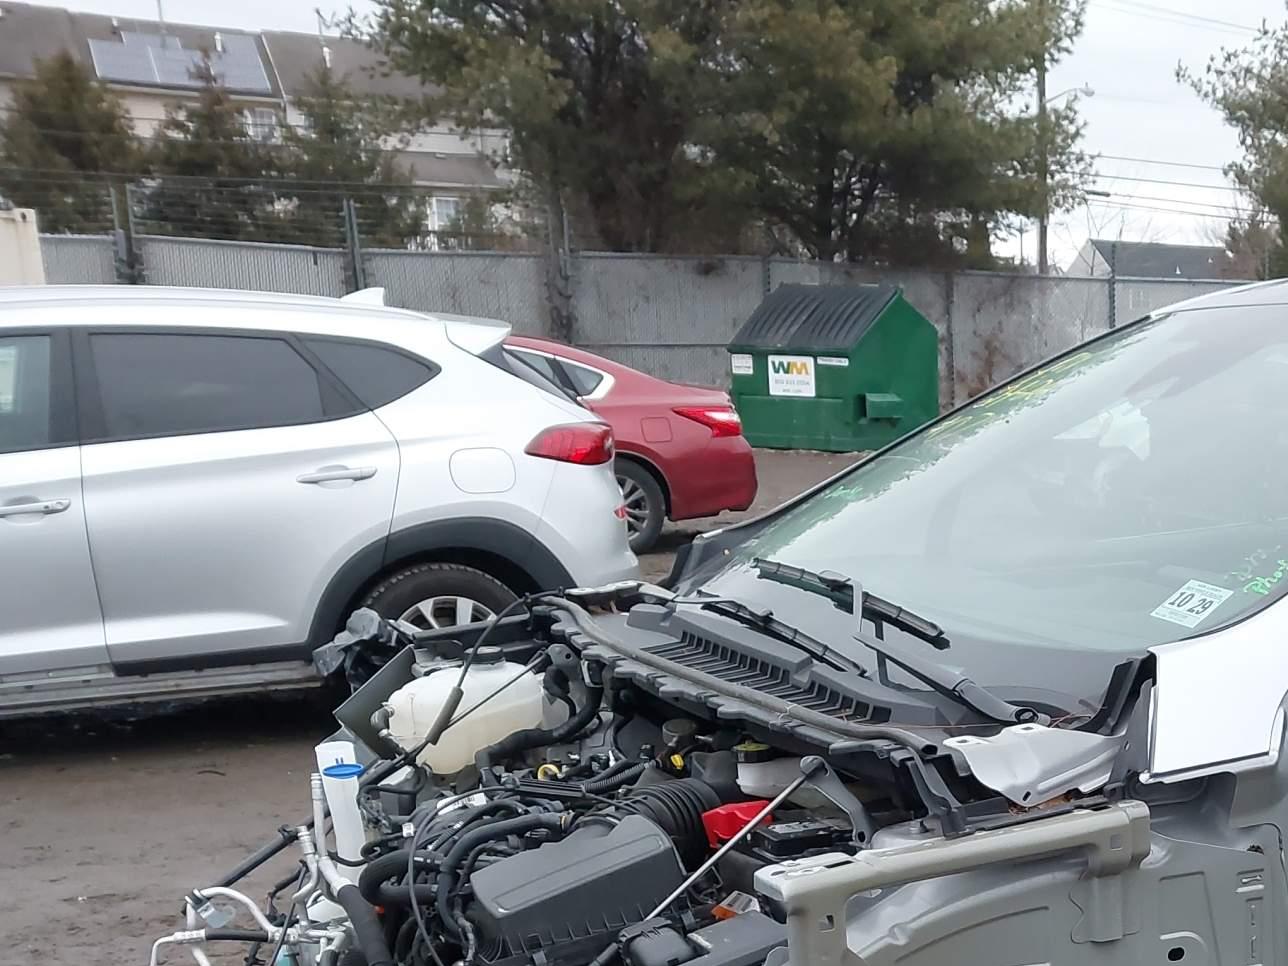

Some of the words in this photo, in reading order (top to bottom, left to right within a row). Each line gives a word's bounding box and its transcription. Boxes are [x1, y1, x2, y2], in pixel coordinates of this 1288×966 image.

[771, 360, 809, 375] WM
[1168, 591, 1195, 608] 10
[1187, 598, 1214, 615] 29
